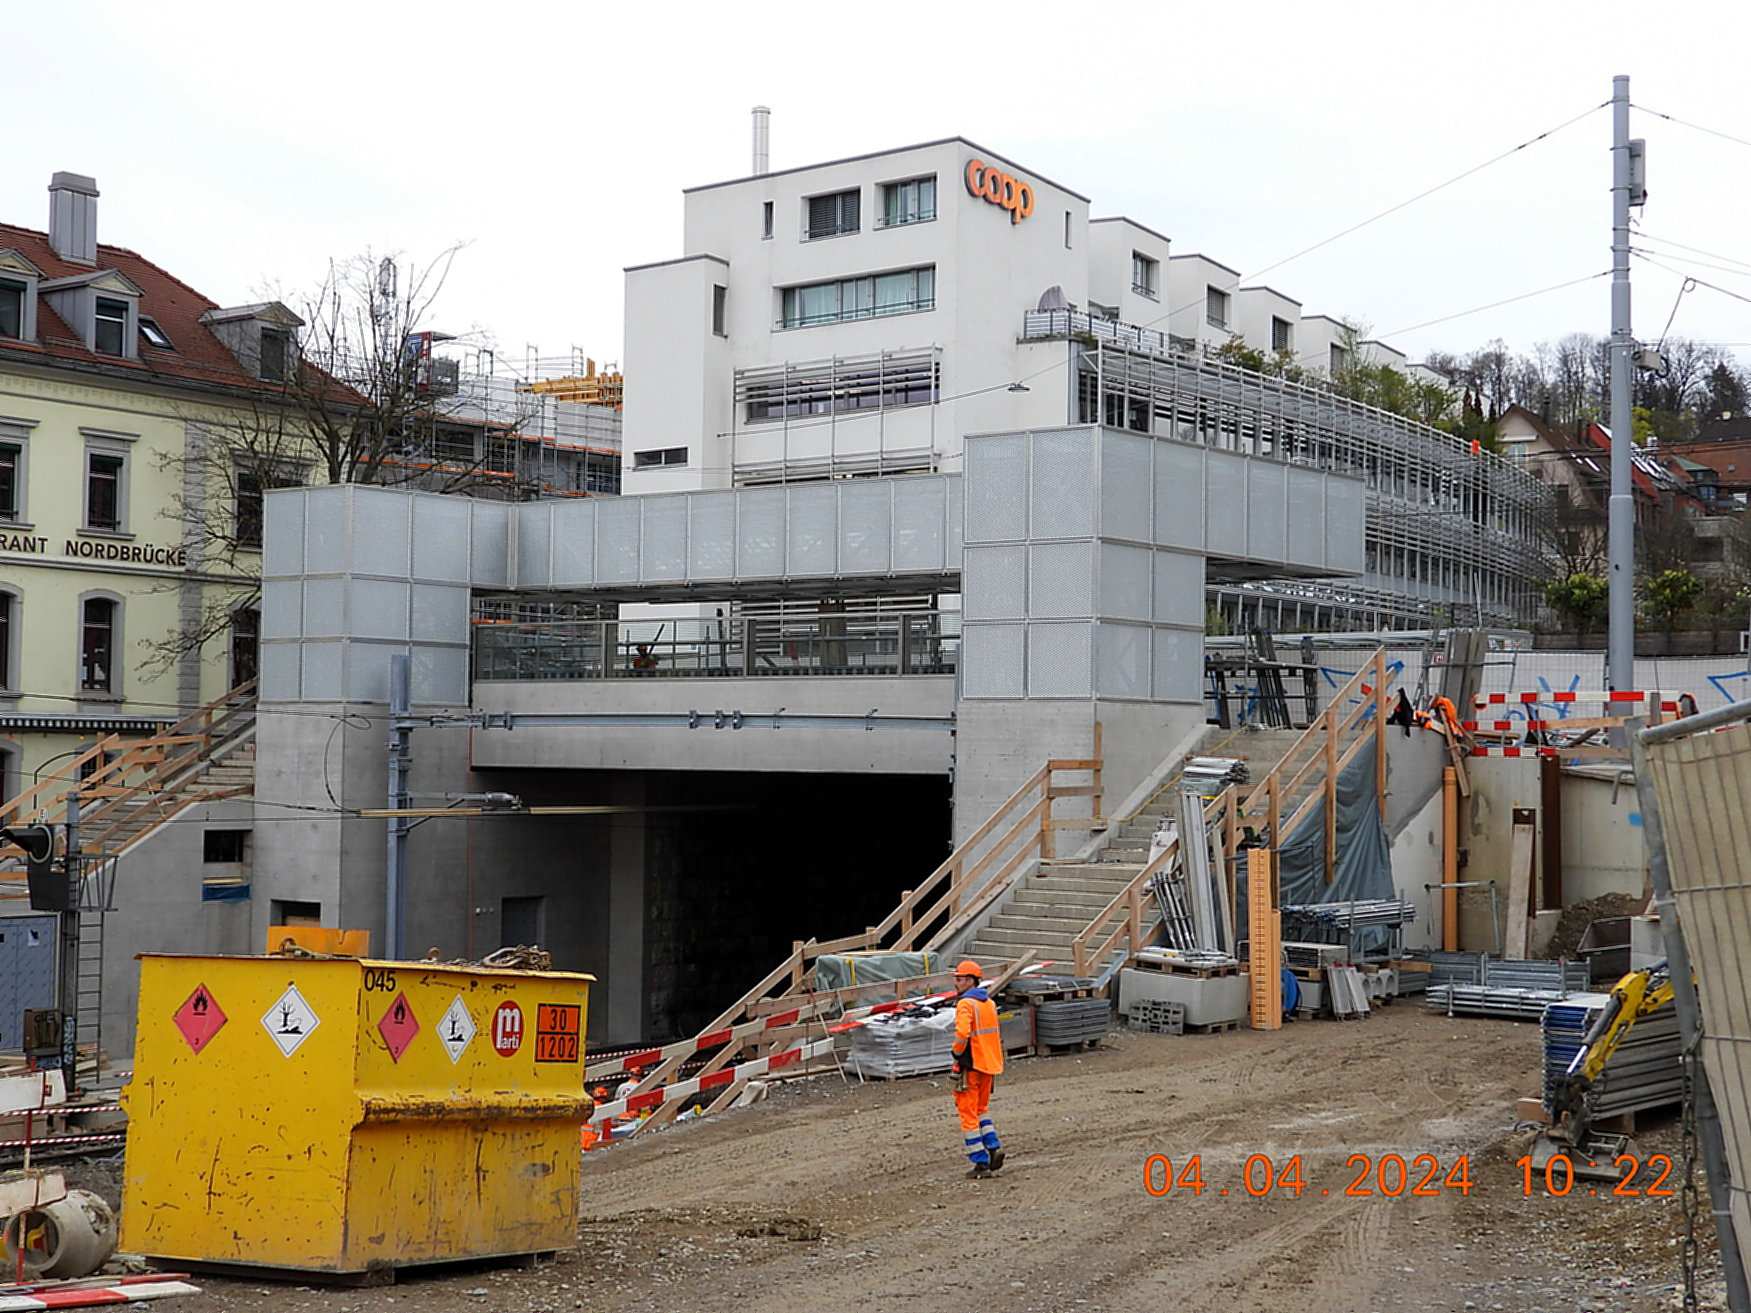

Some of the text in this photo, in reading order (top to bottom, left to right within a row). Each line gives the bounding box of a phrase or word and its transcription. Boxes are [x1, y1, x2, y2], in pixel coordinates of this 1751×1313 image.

[964, 159, 1034, 225] coop
[0, 534, 187, 567] RANT NORDBRÜCKE
[364, 970, 397, 992] 045
[550, 1008, 567, 1030] 30
[540, 1036, 575, 1058] 1202
